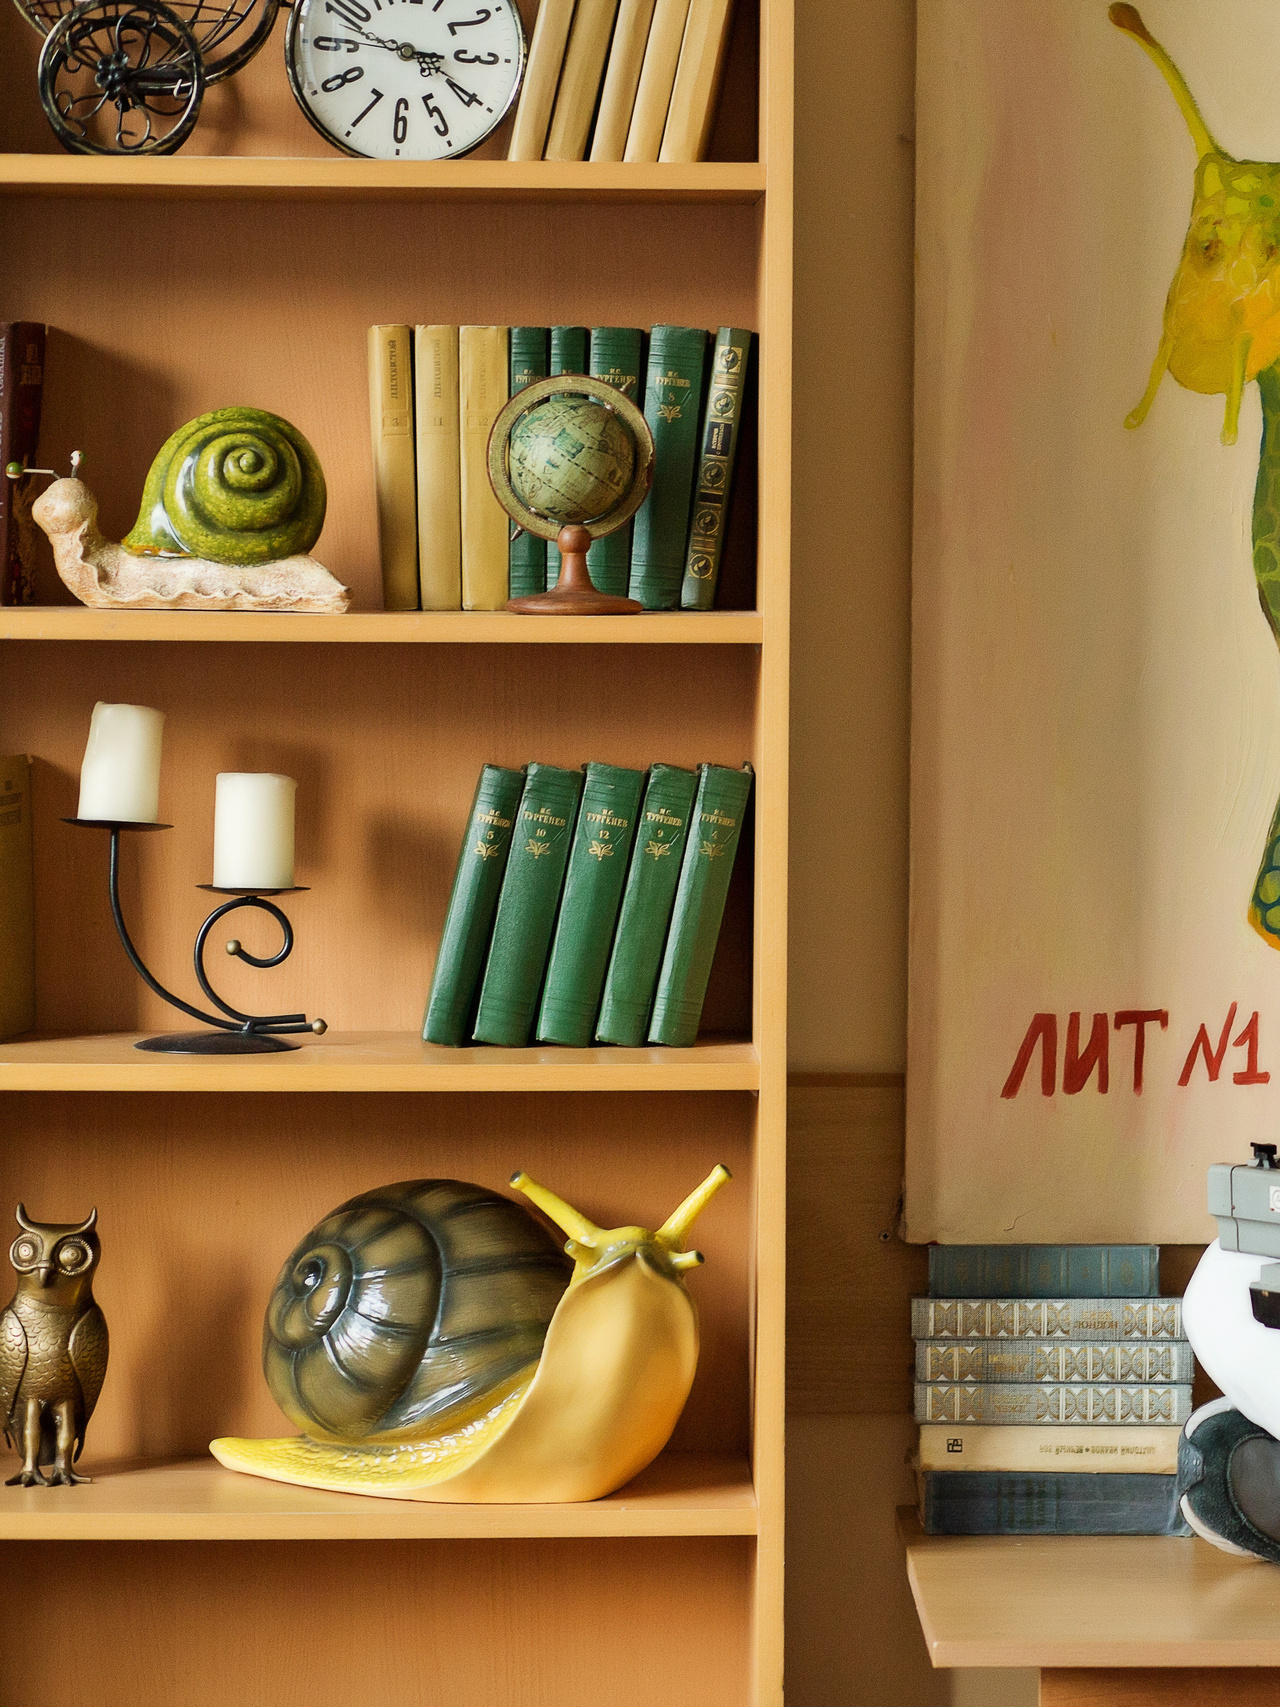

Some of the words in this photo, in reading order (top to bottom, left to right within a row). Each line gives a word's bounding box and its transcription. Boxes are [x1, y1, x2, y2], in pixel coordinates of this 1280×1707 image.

[325, 0, 372, 31] 10
[447, 8, 492, 36] 2
[313, 35, 361, 54] 9
[453, 48, 501, 66] 3
[320, 65, 365, 94] 8
[445, 77, 484, 108] 4
[350, 87, 385, 128] 7
[421, 92, 450, 138] 5
[392, 96, 409, 145] 6
[476, 812, 512, 828] ТУРГЕНЕВ
[523, 810, 566, 827] ТУРГЕНЕВ
[586, 812, 629, 828] ТУРГЕНЕВ
[646, 811, 683, 827] ТУРГЕНЕВ
[701, 812, 736, 827] ТУРГЕНЕВ
[486, 830, 495, 840] 5
[535, 828, 547, 837] 10
[598, 830, 610, 839] 12
[657, 829, 664, 838] 9
[1000, 1008, 1170, 1098] ЛИТ
